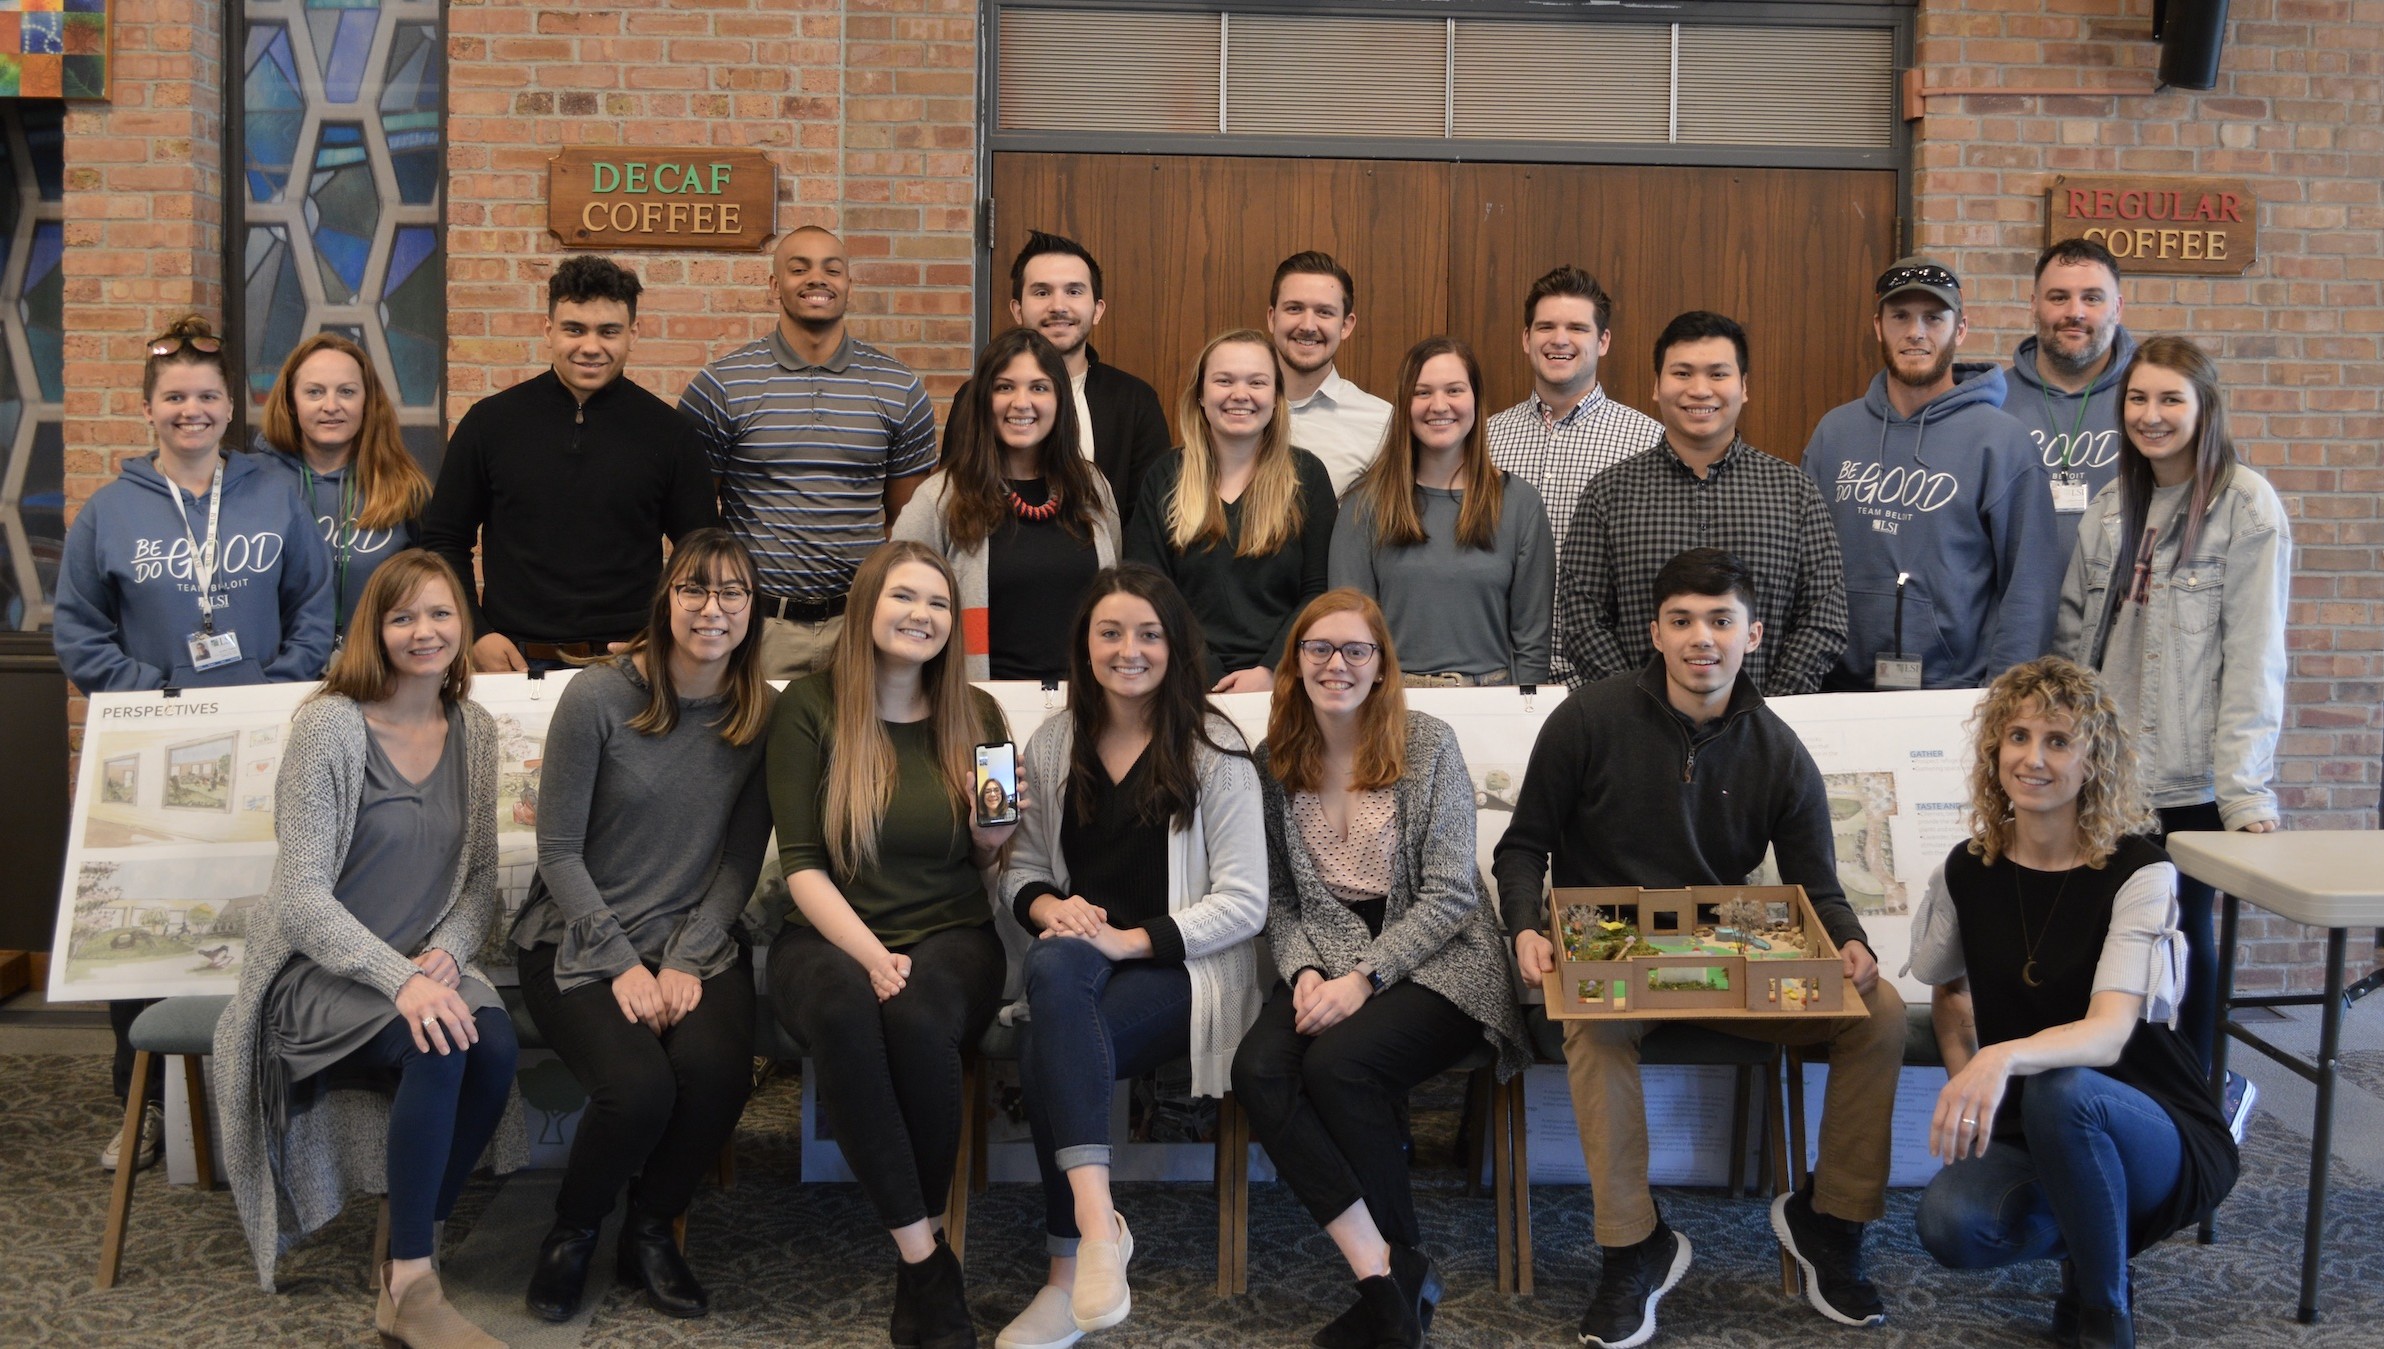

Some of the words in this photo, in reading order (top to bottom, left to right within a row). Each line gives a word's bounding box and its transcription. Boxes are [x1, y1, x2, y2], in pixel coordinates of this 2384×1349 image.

[591, 162, 733, 194] DECAF
[2066, 188, 2243, 222] REGULAR
[582, 201, 743, 234] COFFEE
[1835, 484, 1851, 503] DO
[1838, 460, 1862, 480] BE
[1854, 462, 1958, 512] GOOD
[1857, 506, 1881, 516] TEAM
[1880, 520, 1899, 534] LSI
[135, 538, 163, 559] BE
[167, 532, 284, 580] GOOD
[134, 561, 163, 583] DO
[177, 583, 201, 592] TEA
[209, 594, 230, 608] LSI
[102, 702, 219, 719] PERSPECTIVES
[1909, 750, 1944, 758] GATHER
